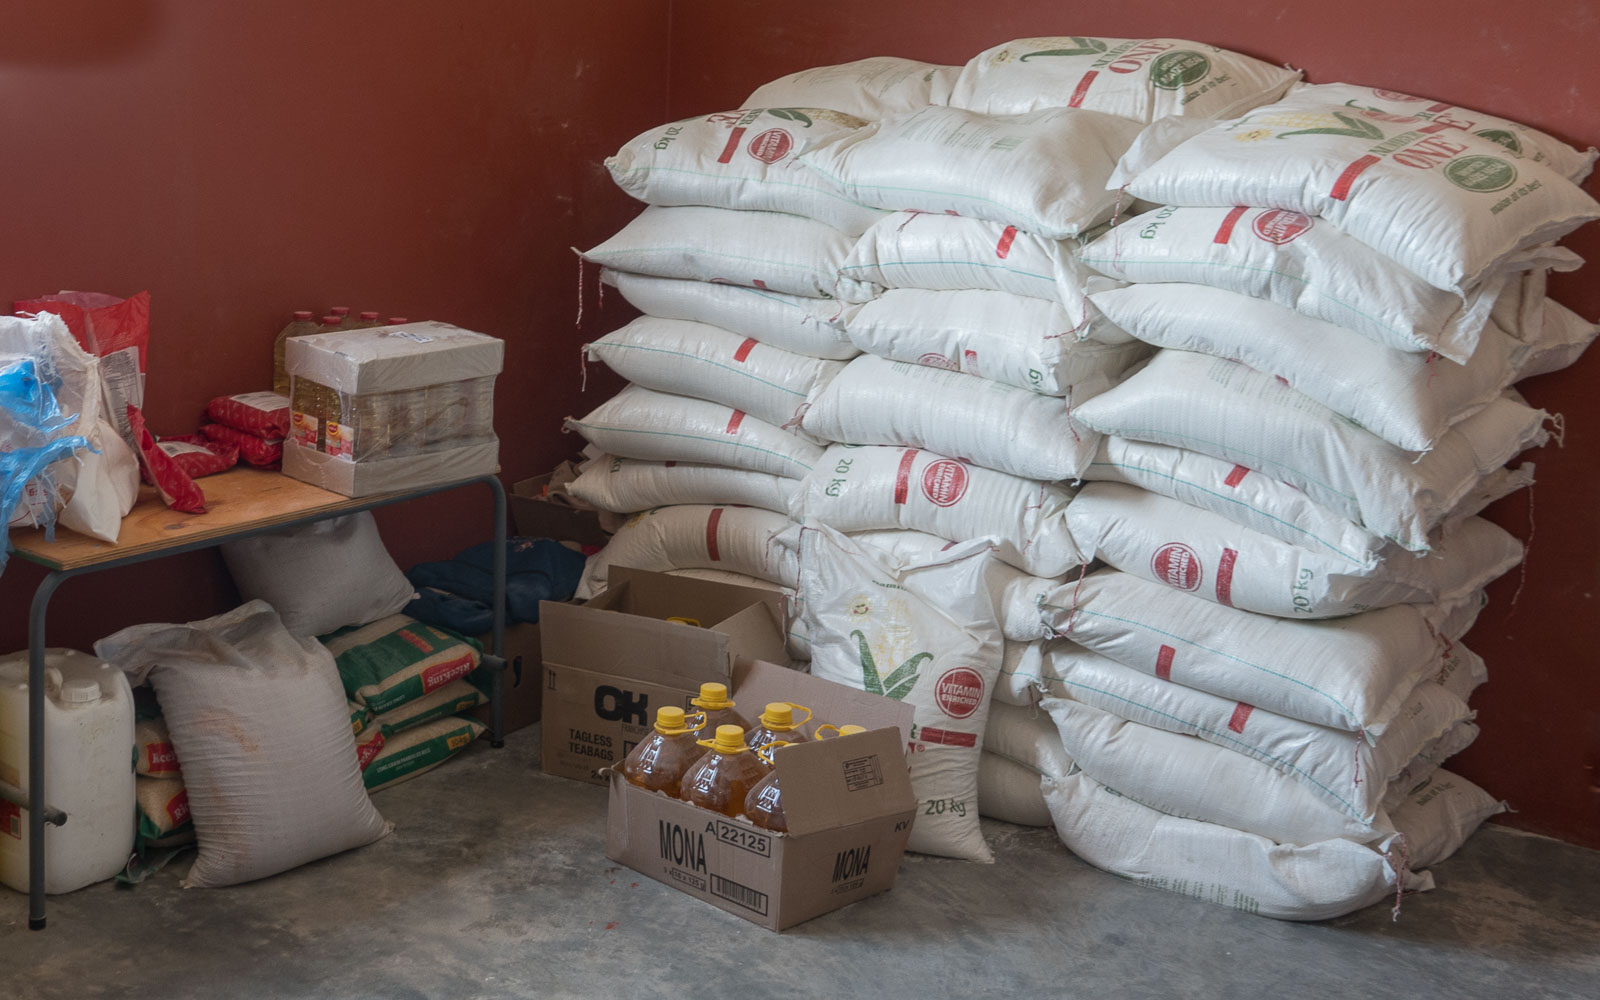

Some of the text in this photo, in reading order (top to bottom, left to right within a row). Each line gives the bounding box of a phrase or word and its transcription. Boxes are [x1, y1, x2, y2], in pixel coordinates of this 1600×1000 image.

[1109, 42, 1176, 74] ONE
[653, 126, 684, 151] 20 kg
[764, 130, 782, 160] VITAMIN
[1391, 134, 1469, 170] ONE
[1140, 222, 1166, 241] kg
[825, 458, 854, 499] 20 kg
[931, 462, 946, 499] ENRICHED
[937, 463, 957, 506] VITAMIN
[1167, 546, 1184, 588] VITAMIN
[1179, 551, 1191, 590] ENRICHED
[1292, 568, 1314, 614] 20 kg
[426, 662, 472, 687] RiceKing
[594, 685, 649, 727] OK
[941, 682, 982, 699] VITAMIN
[941, 694, 978, 706] ENRICHED
[569, 728, 613, 748] TAGLESS
[569, 741, 614, 762] TEABAGS
[925, 797, 967, 817] 20 kg
[705, 821, 766, 852] A 22125
[894, 819, 911, 833] KV
[659, 820, 707, 875] MONA
[831, 844, 872, 884] MONA
